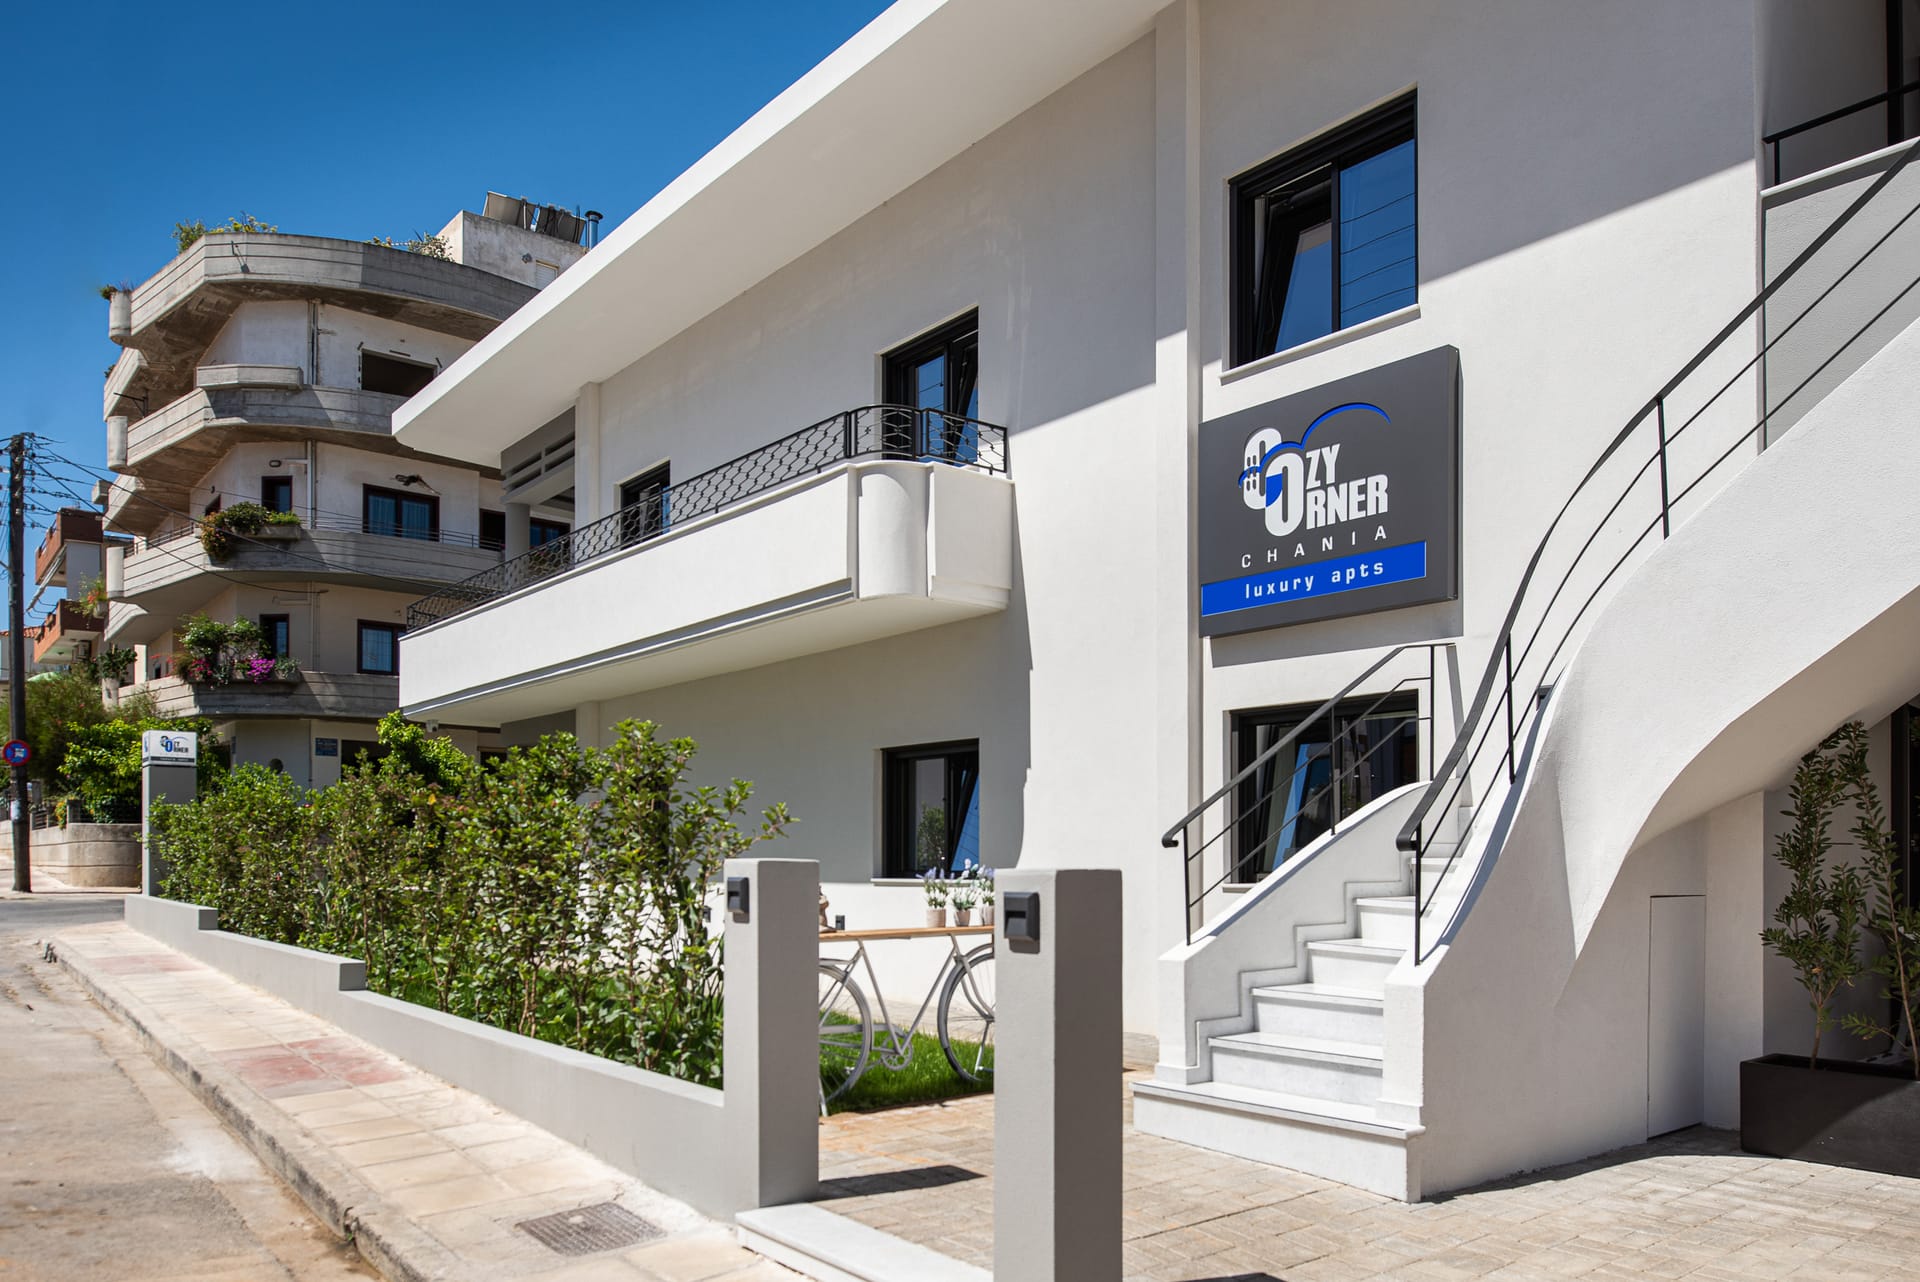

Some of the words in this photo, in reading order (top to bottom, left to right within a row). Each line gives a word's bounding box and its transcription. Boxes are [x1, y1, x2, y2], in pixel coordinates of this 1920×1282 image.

[1242, 525, 1387, 568] CHANIA
[1245, 575, 1314, 599] luxury
[1331, 561, 1384, 585] apts
